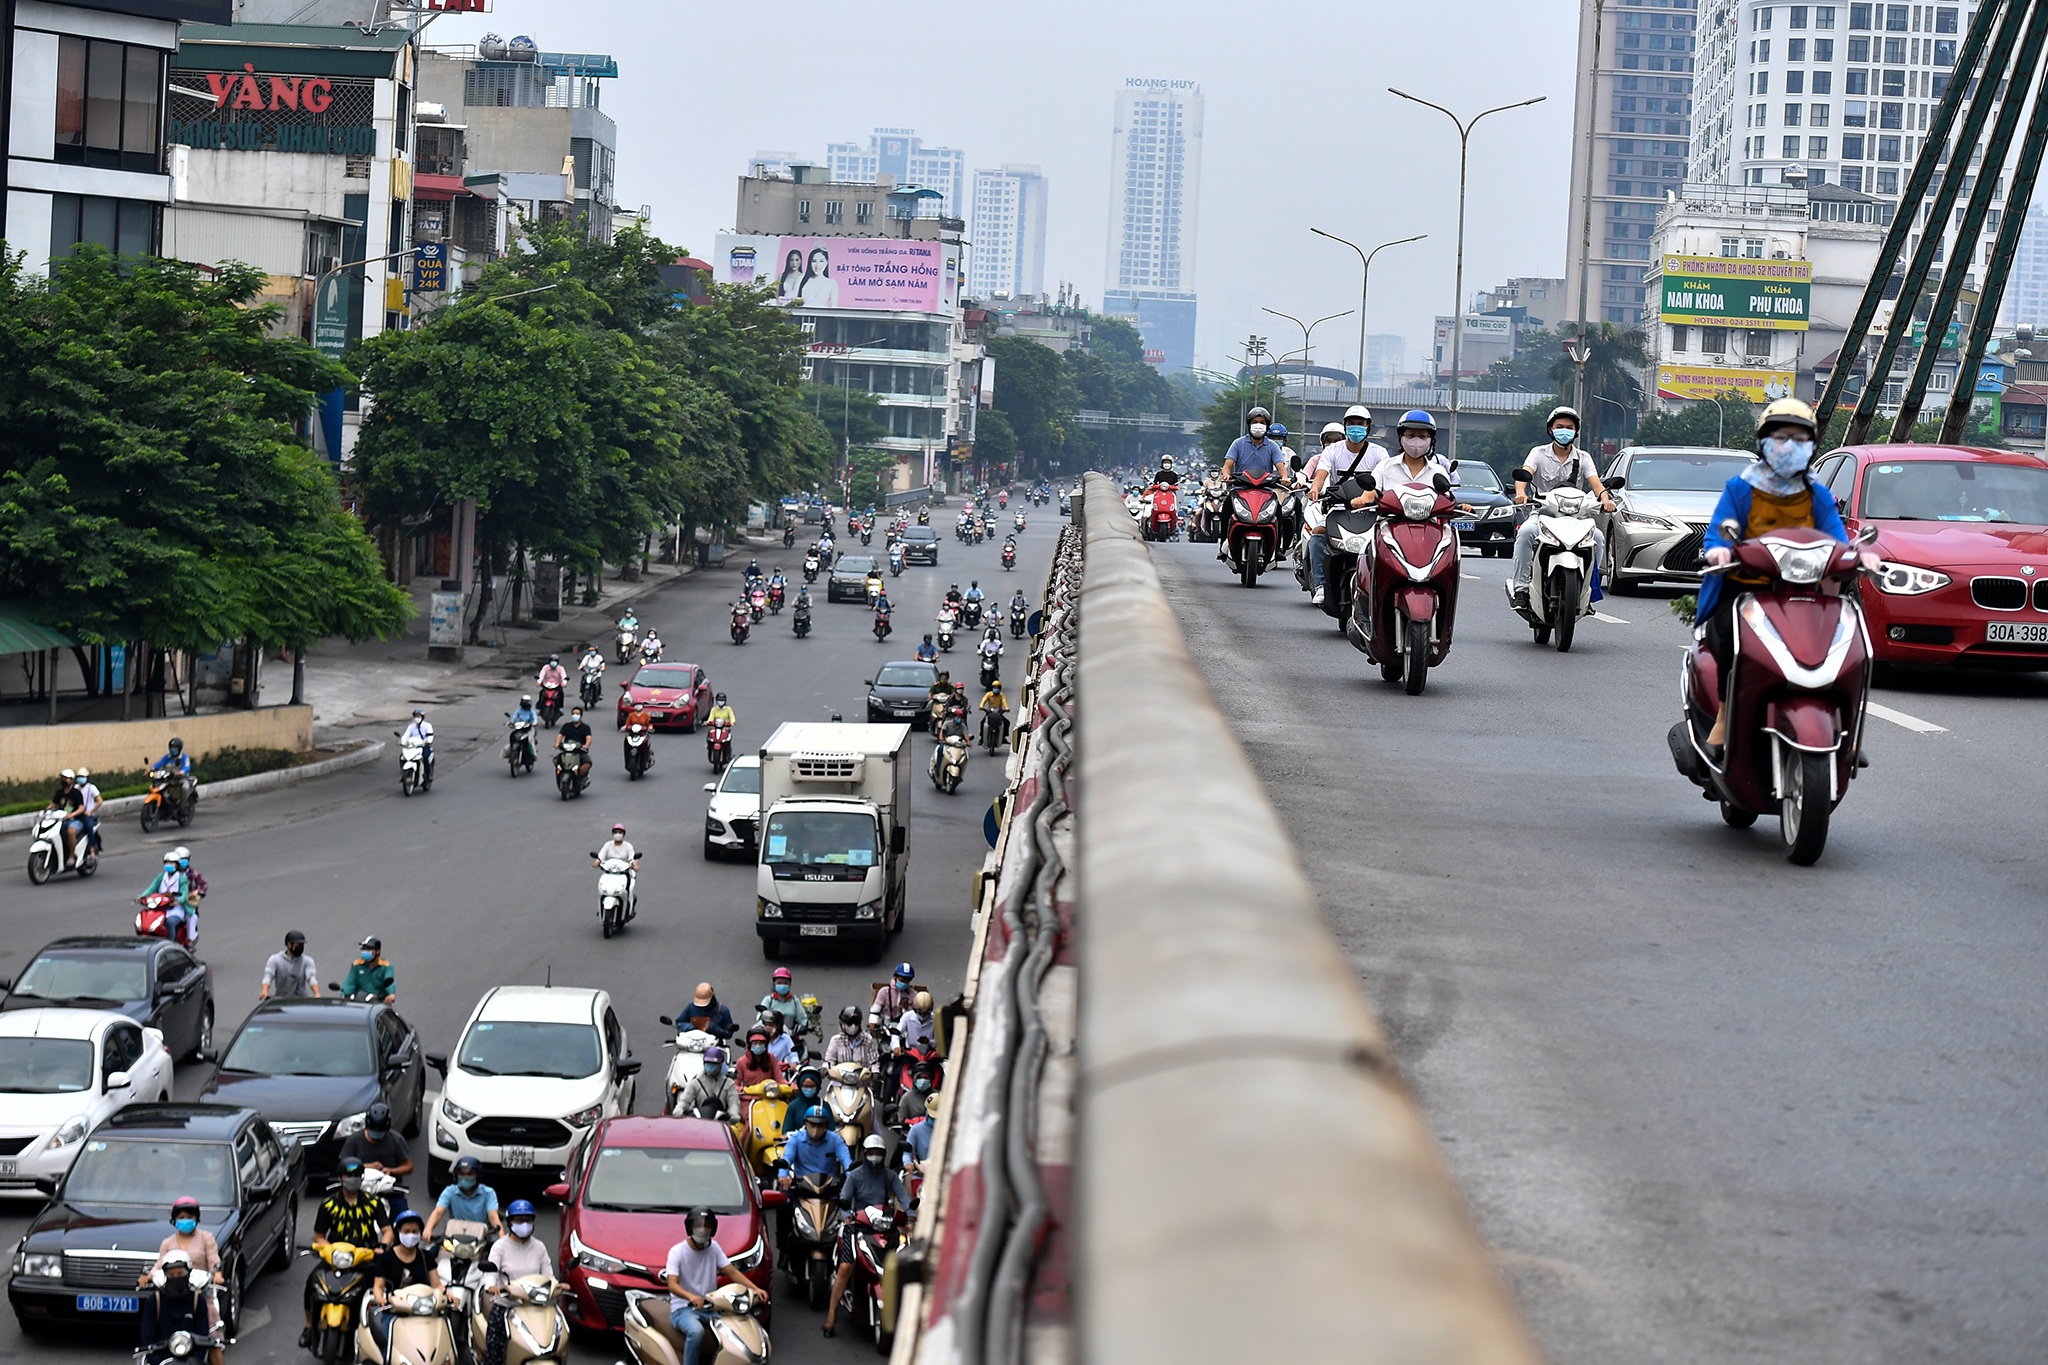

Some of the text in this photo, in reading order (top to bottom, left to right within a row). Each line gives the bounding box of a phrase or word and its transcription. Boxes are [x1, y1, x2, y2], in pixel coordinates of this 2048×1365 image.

[206, 63, 333, 114] VÀNG
[1170, 79, 1195, 89] HUY
[851, 264, 871, 273] TÔNG
[874, 261, 908, 273] TRẮNG
[911, 265, 938, 276] HỒNG
[1682, 260, 1704, 272] PHÒNG
[1706, 261, 1726, 274] KHÁM
[1728, 263, 1737, 274] ĐA
[1738, 264, 1756, 275] KHOA
[1757, 265, 1766, 275] 52
[1767, 262, 1792, 277] NGUYỄN
[421, 270, 440, 279] VIP
[419, 280, 440, 288] 24K
[848, 276, 928, 289] LÀM MỜ SẠM NÁM
[1684, 280, 1710, 290] KHÁM
[1764, 284, 1791, 294] KHÁM
[1667, 291, 1724, 310] NAM KHOA
[1749, 296, 1803, 316] PHỤ KHOA
[1730, 318, 1743, 326] 024
[1745, 319, 1760, 327] 3511
[1144, 349, 1165, 357] OTEL
